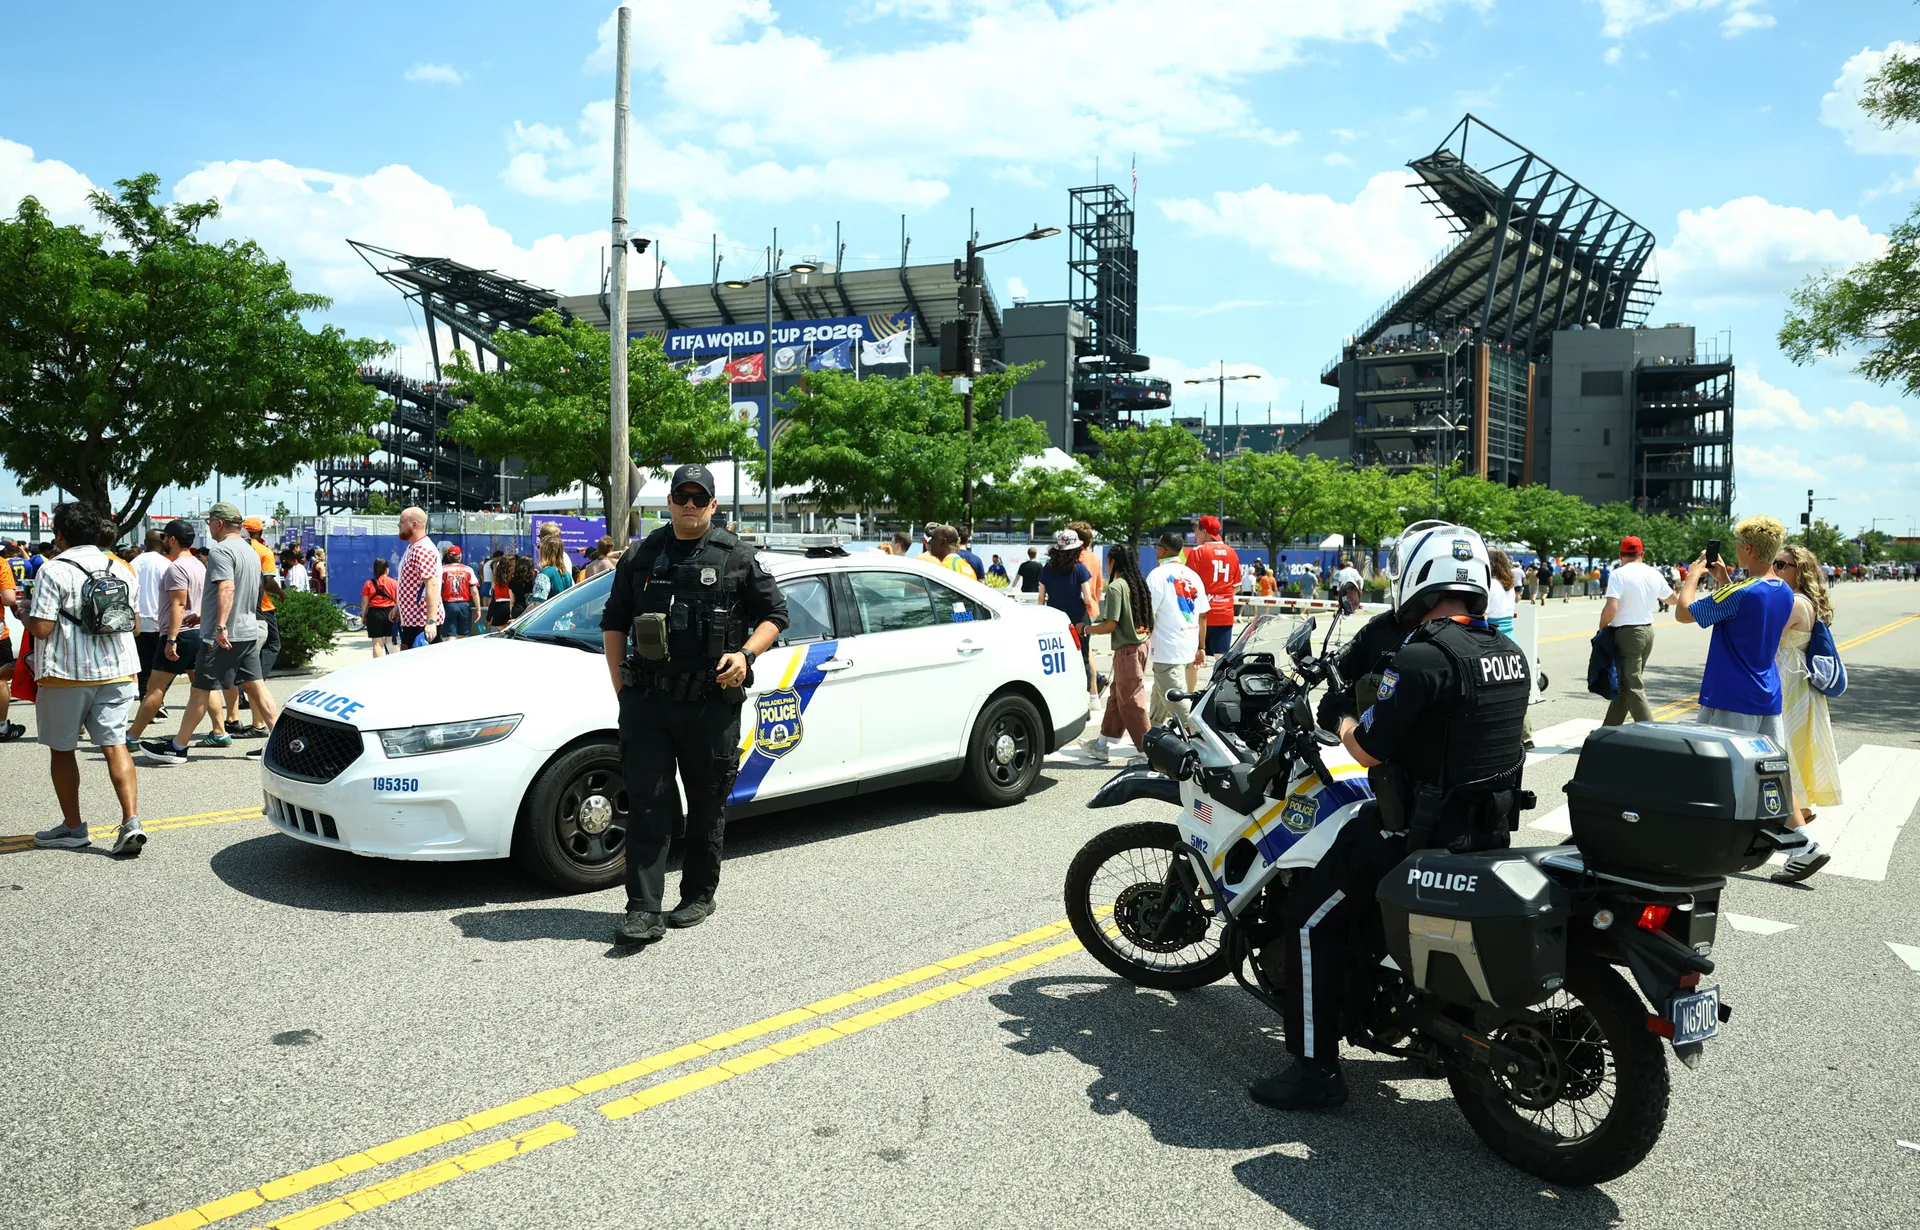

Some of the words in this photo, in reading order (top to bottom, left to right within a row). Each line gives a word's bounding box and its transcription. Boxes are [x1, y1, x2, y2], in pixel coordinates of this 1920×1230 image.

[672, 334, 705, 350] FIFA
[707, 331, 765, 348] WORLD
[771, 328, 800, 343] CUP
[802, 323, 864, 342] 2026
[1211, 560, 1230, 582] 14
[1038, 637, 1065, 651] DIAL
[1041, 652, 1066, 675] 911
[1480, 655, 1525, 682] POLICE
[288, 690, 365, 721] POLICE
[759, 697, 795, 707] PHILADELPHIA
[761, 704, 797, 724] POLICE
[1747, 740, 1772, 753] 5M2
[373, 777, 419, 792] 195350
[1289, 802, 1314, 817] POLICE
[1190, 834, 1208, 854] 5M2
[1407, 868, 1478, 893] POLICE
